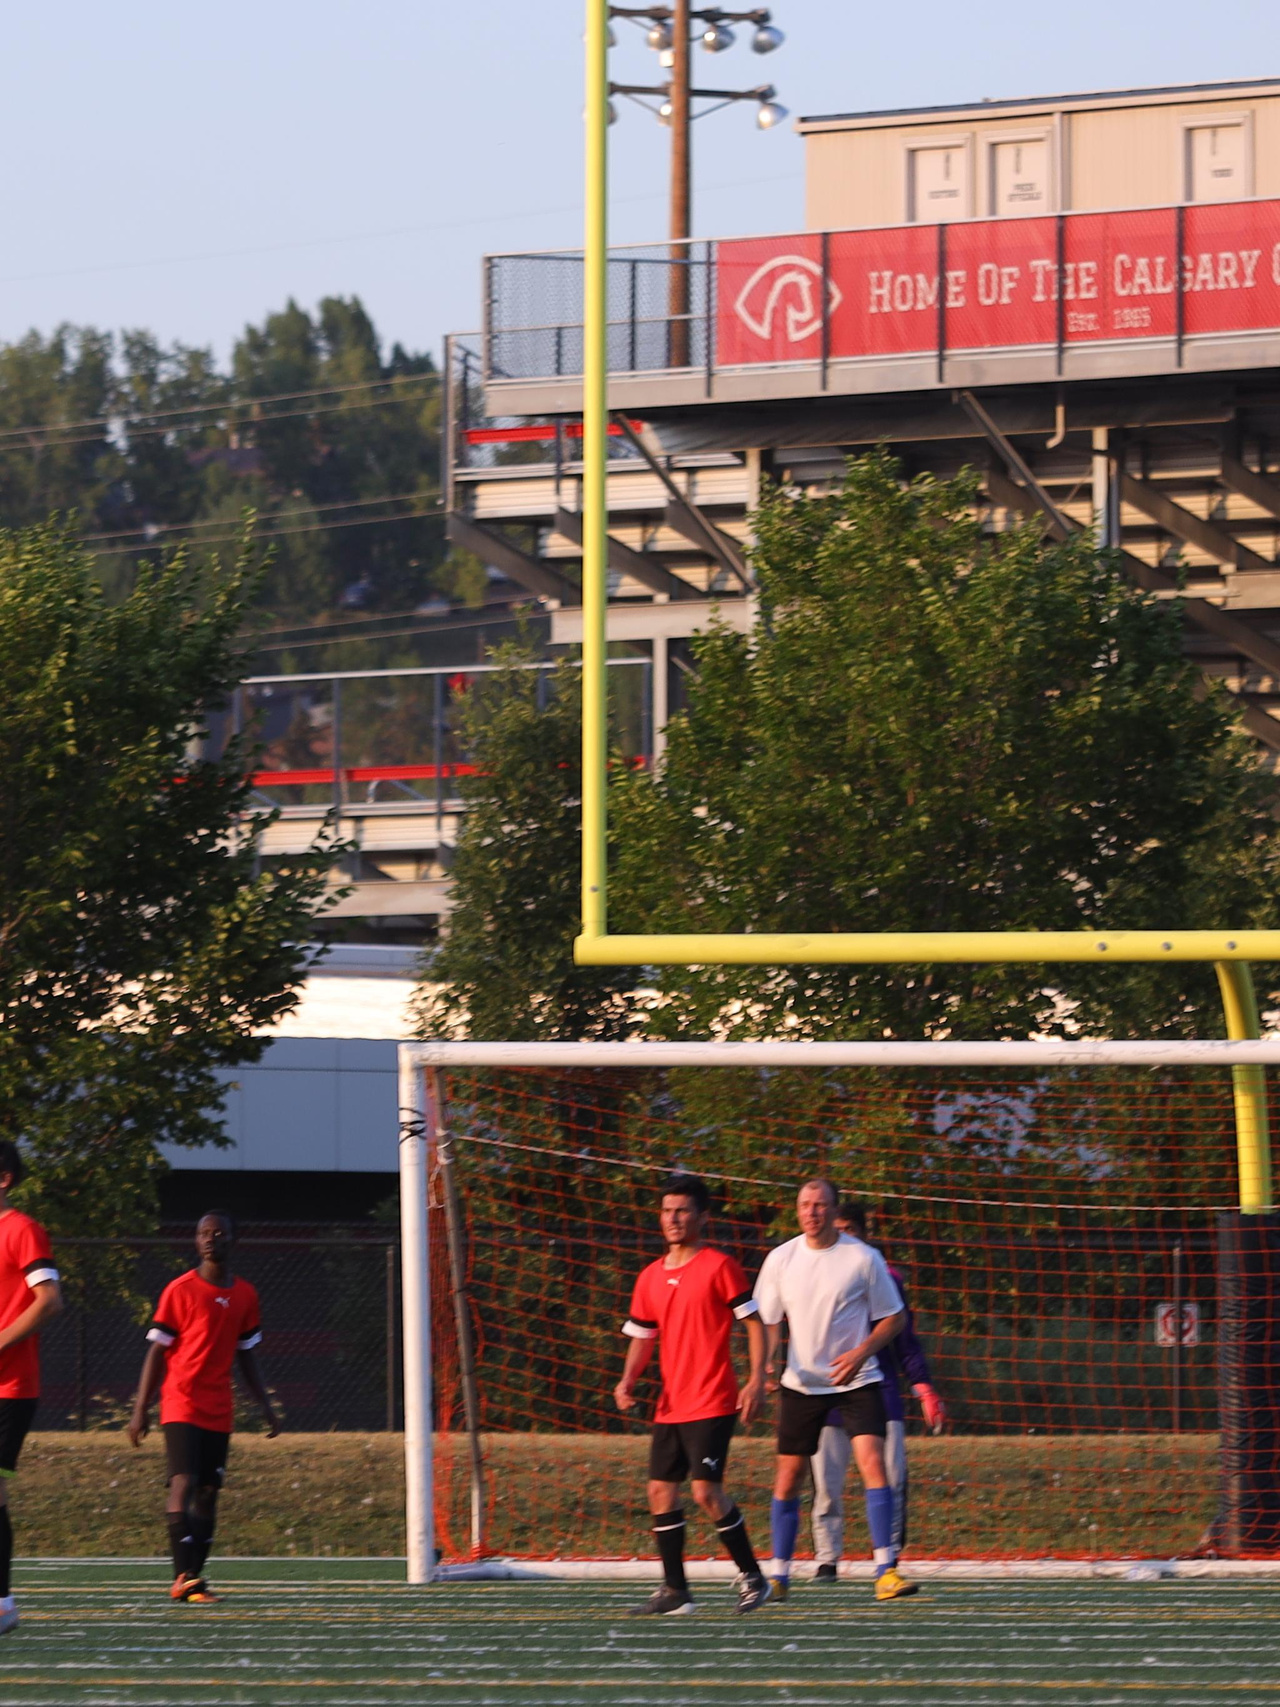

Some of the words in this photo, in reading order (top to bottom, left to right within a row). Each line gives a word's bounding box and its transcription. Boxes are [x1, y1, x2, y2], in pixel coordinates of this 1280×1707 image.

[867, 270, 967, 314] HOME
[977, 263, 1021, 306] OF
[1029, 258, 1098, 302] THE
[1113, 249, 1262, 297] CALGARY
